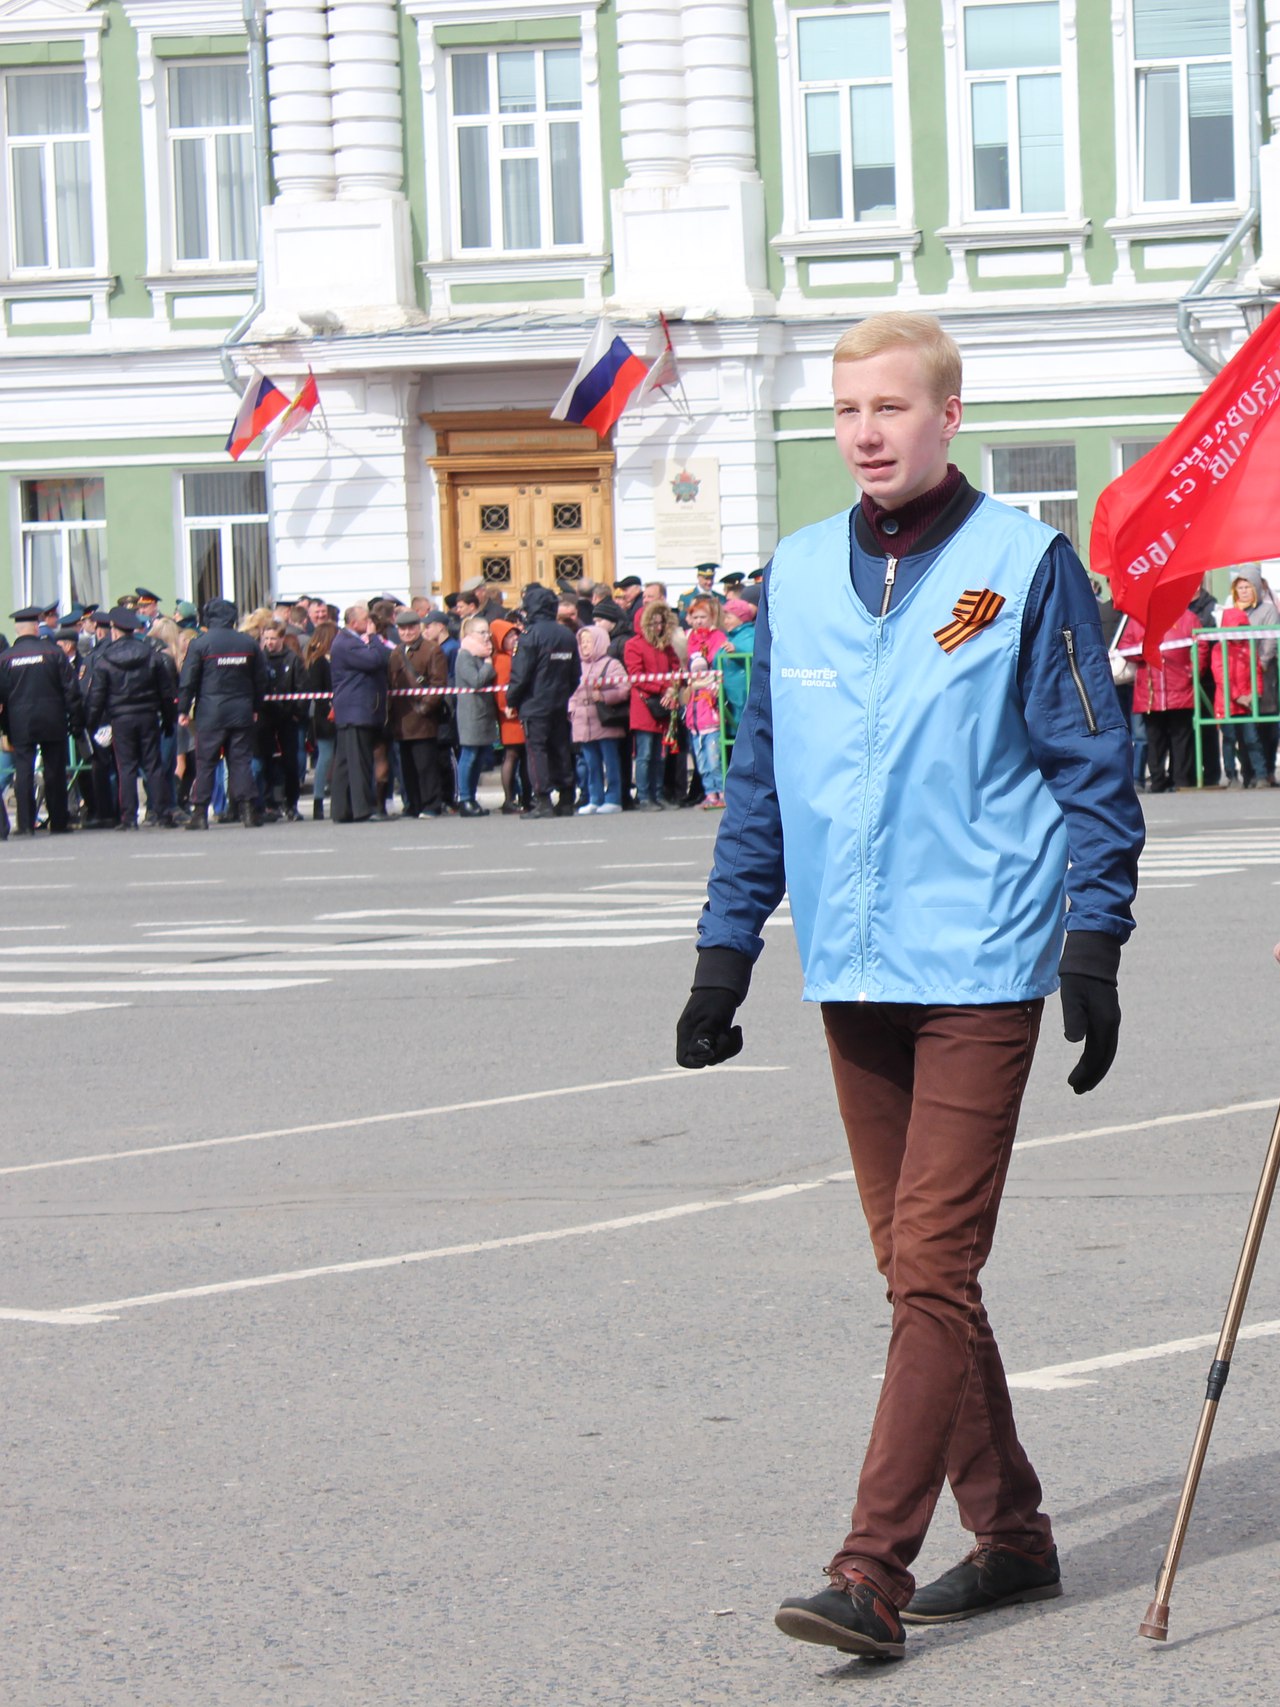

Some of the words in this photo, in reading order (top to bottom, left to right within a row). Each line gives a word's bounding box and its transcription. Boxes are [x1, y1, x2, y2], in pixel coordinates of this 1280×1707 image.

[11, 655, 44, 668] ПОЛИЦИЯ
[217, 656, 247, 666] ПОЛИЦИЯ
[781, 667, 838, 680] ВОЛОНТЁР
[801, 680, 837, 688] ВОЛОГДА
